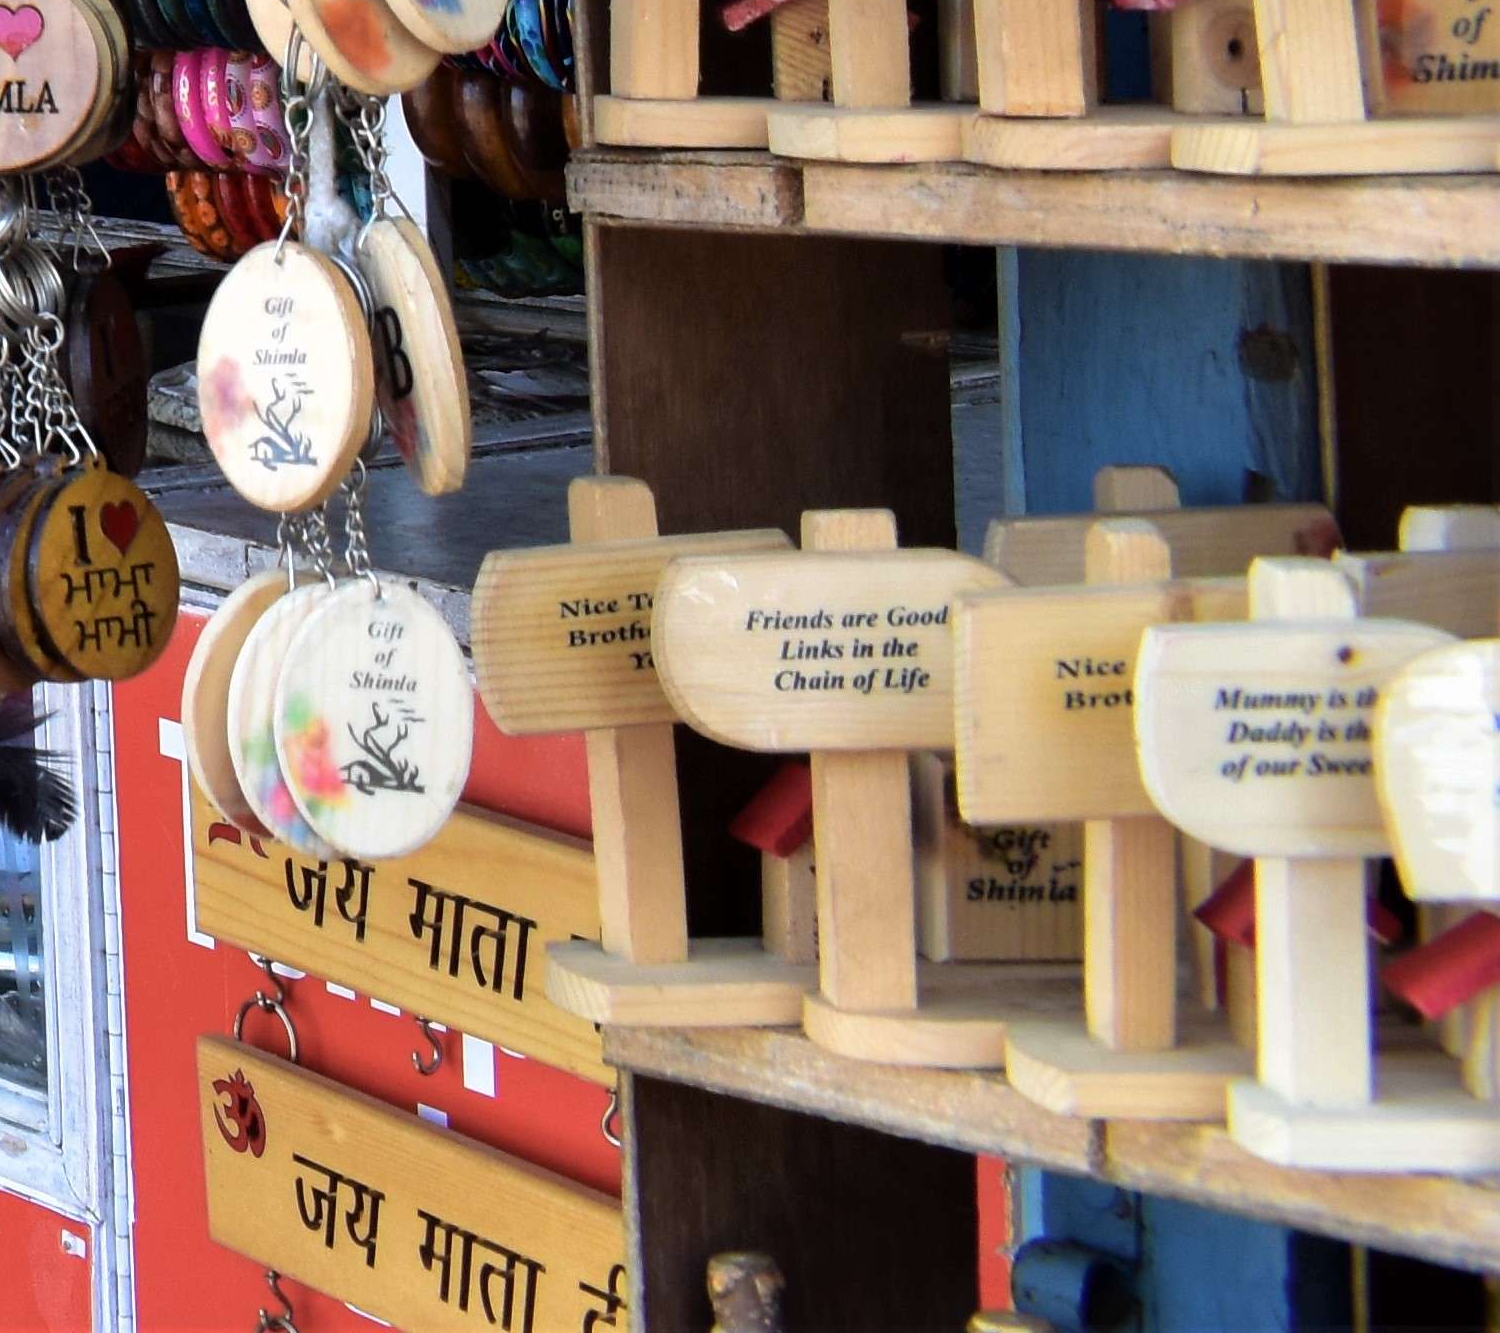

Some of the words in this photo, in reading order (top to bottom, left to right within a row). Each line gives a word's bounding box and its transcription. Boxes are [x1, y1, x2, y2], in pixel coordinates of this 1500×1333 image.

[1452, 9, 1486, 42] of
[264, 296, 296, 317] Gift
[271, 322, 289, 344] of
[252, 346, 309, 367] Shimla
[68, 505, 92, 567] I
[368, 621, 404, 640] Gift
[745, 609, 833, 631] Friends
[842, 611, 878, 628] are
[887, 605, 948, 627] Good
[374, 648, 397, 668] of
[780, 640, 844, 661] Links
[852, 639, 874, 658] in
[881, 638, 918, 657] the
[350, 670, 417, 693] Shimla
[774, 670, 845, 692] Chain
[852, 669, 879, 695] of
[883, 667, 931, 689] Life
[1214, 688, 1322, 713] Mummy
[1328, 689, 1348, 708] is
[1226, 720, 1311, 748] Daddy
[1318, 721, 1338, 742] is
[1221, 755, 1247, 780] of
[1255, 757, 1300, 777] our
[1306, 755, 1371, 777] Swee
[285, 856, 375, 942] जय
[408, 877, 537, 1001] माता
[292, 1153, 386, 1269] जय
[417, 1208, 546, 1333] माता
